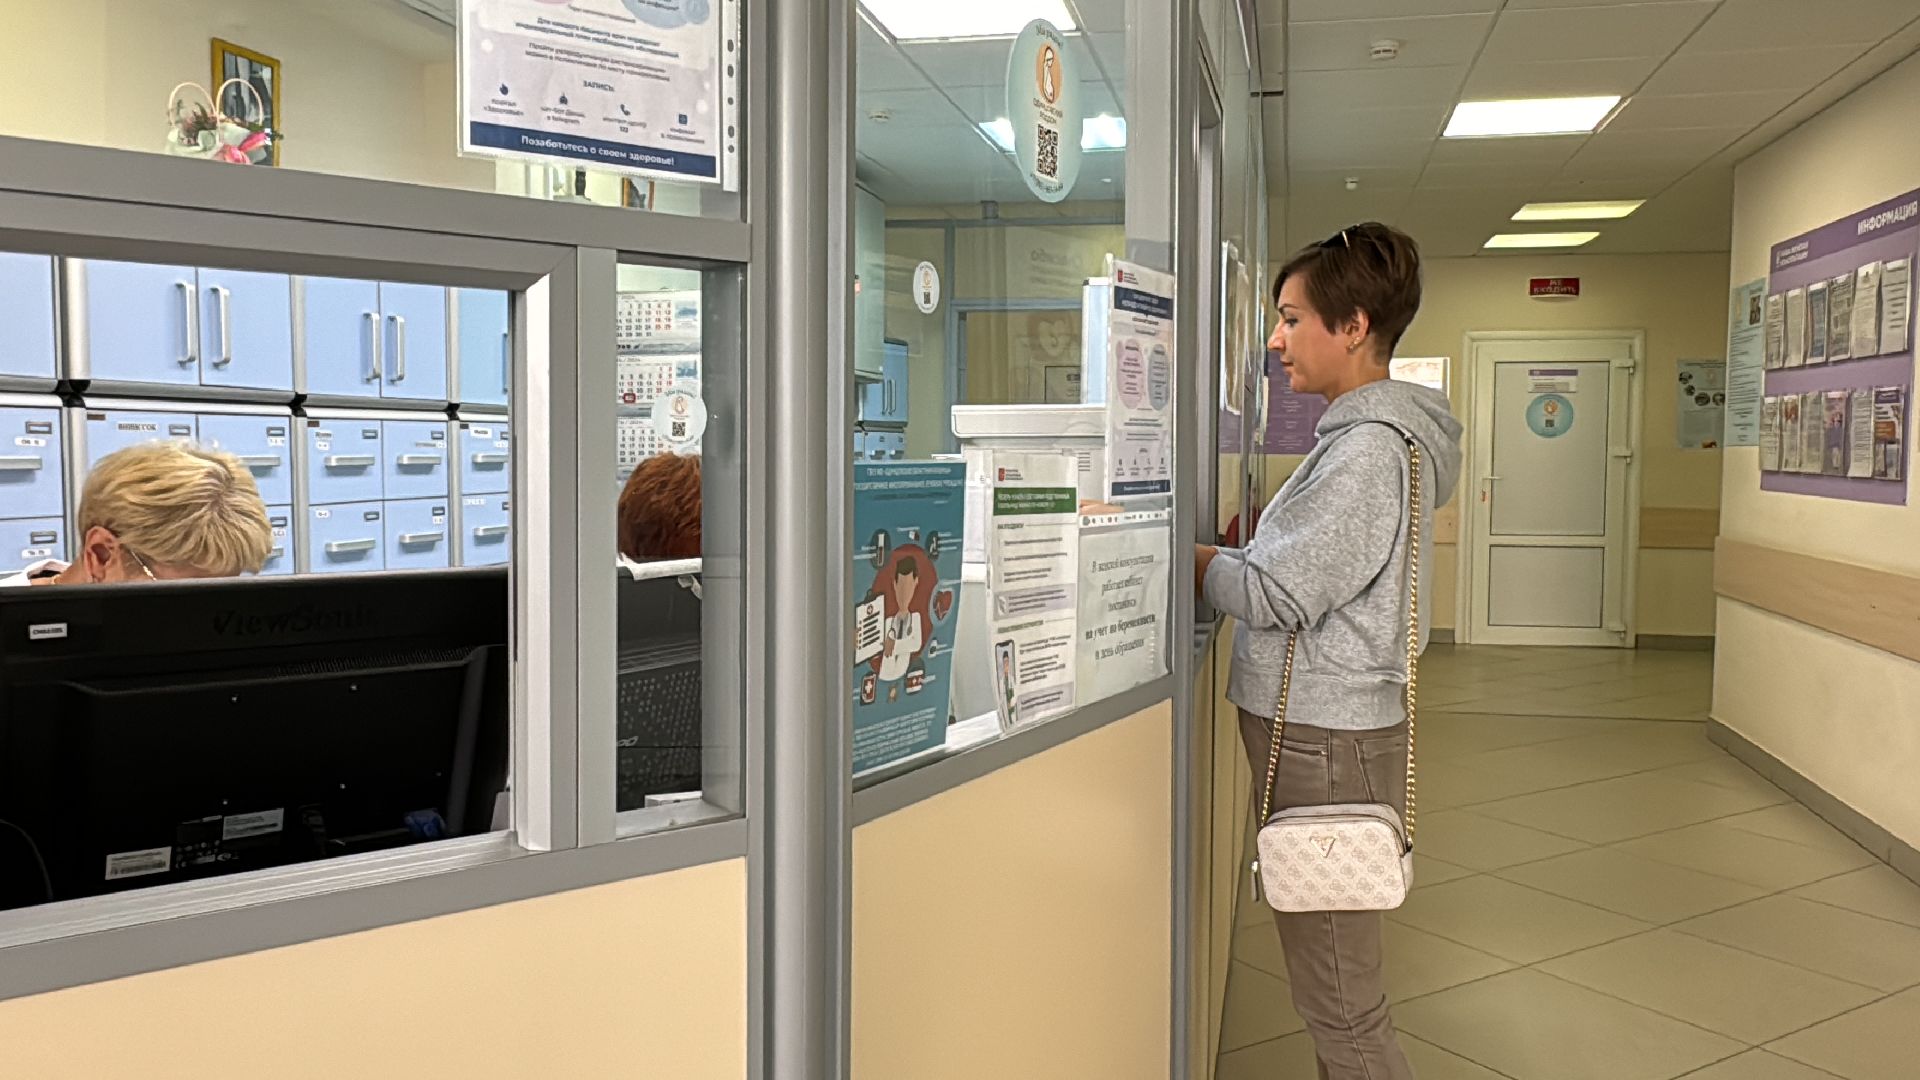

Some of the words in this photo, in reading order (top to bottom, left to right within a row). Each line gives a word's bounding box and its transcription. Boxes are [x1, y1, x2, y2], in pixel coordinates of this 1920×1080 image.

[583, 80, 615, 92] ЗАПИСЬ
[520, 134, 588, 154] Позаботьтесь
[589, 146, 597, 154] о
[598, 149, 627, 158] своем
[629, 152, 675, 165] здоровье!
[1857, 200, 1918, 236] ИНФОРМАЦИЯ
[1086, 629, 1093, 640] на
[1093, 625, 1108, 640] учет
[1109, 624, 1117, 634] по
[1118, 613, 1155, 634] беременности
[1101, 647, 1113, 659] день
[1115, 639, 1144, 656] обращения
